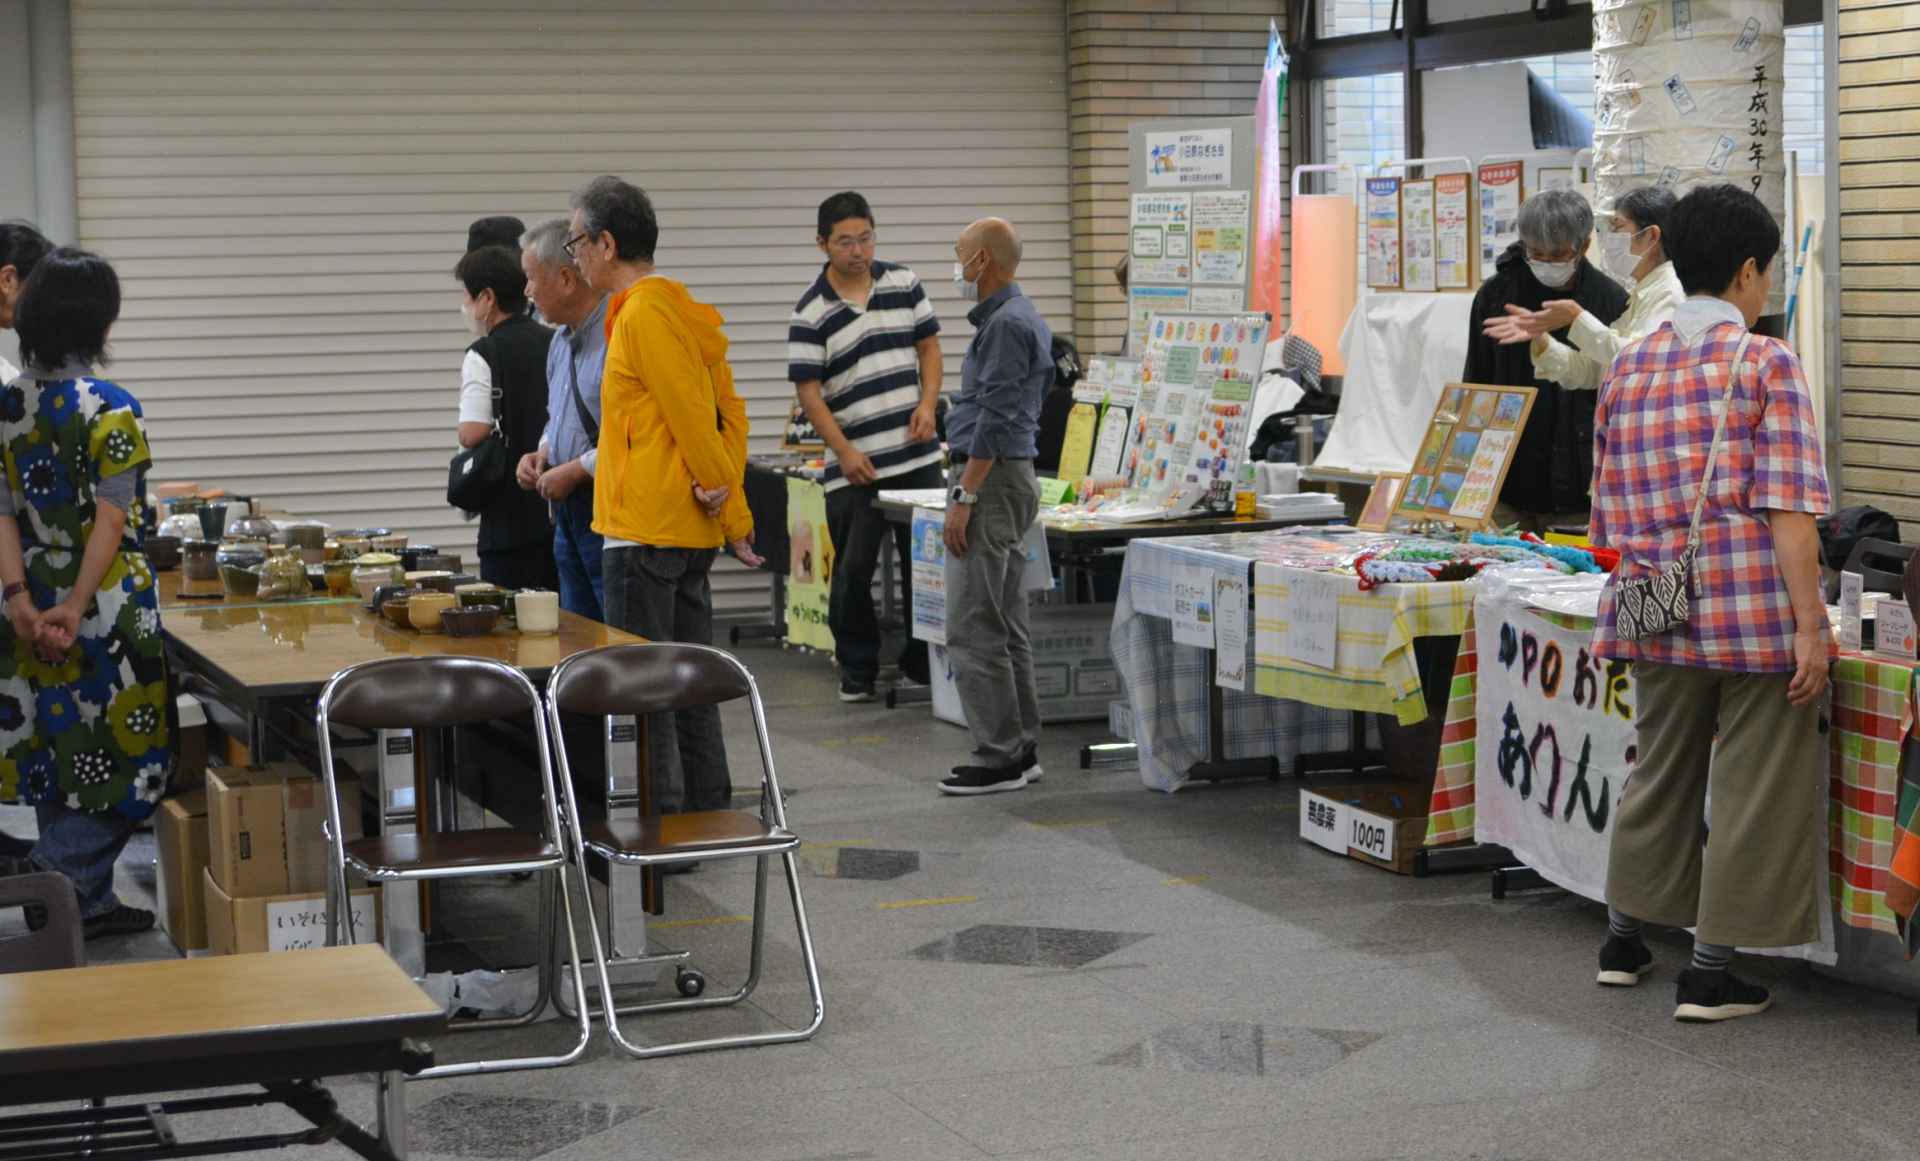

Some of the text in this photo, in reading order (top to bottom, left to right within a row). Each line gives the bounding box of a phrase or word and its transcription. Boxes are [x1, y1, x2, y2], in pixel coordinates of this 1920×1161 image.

[1497, 700, 1637, 834] ありん
[1352, 819, 1385, 853] 100円
